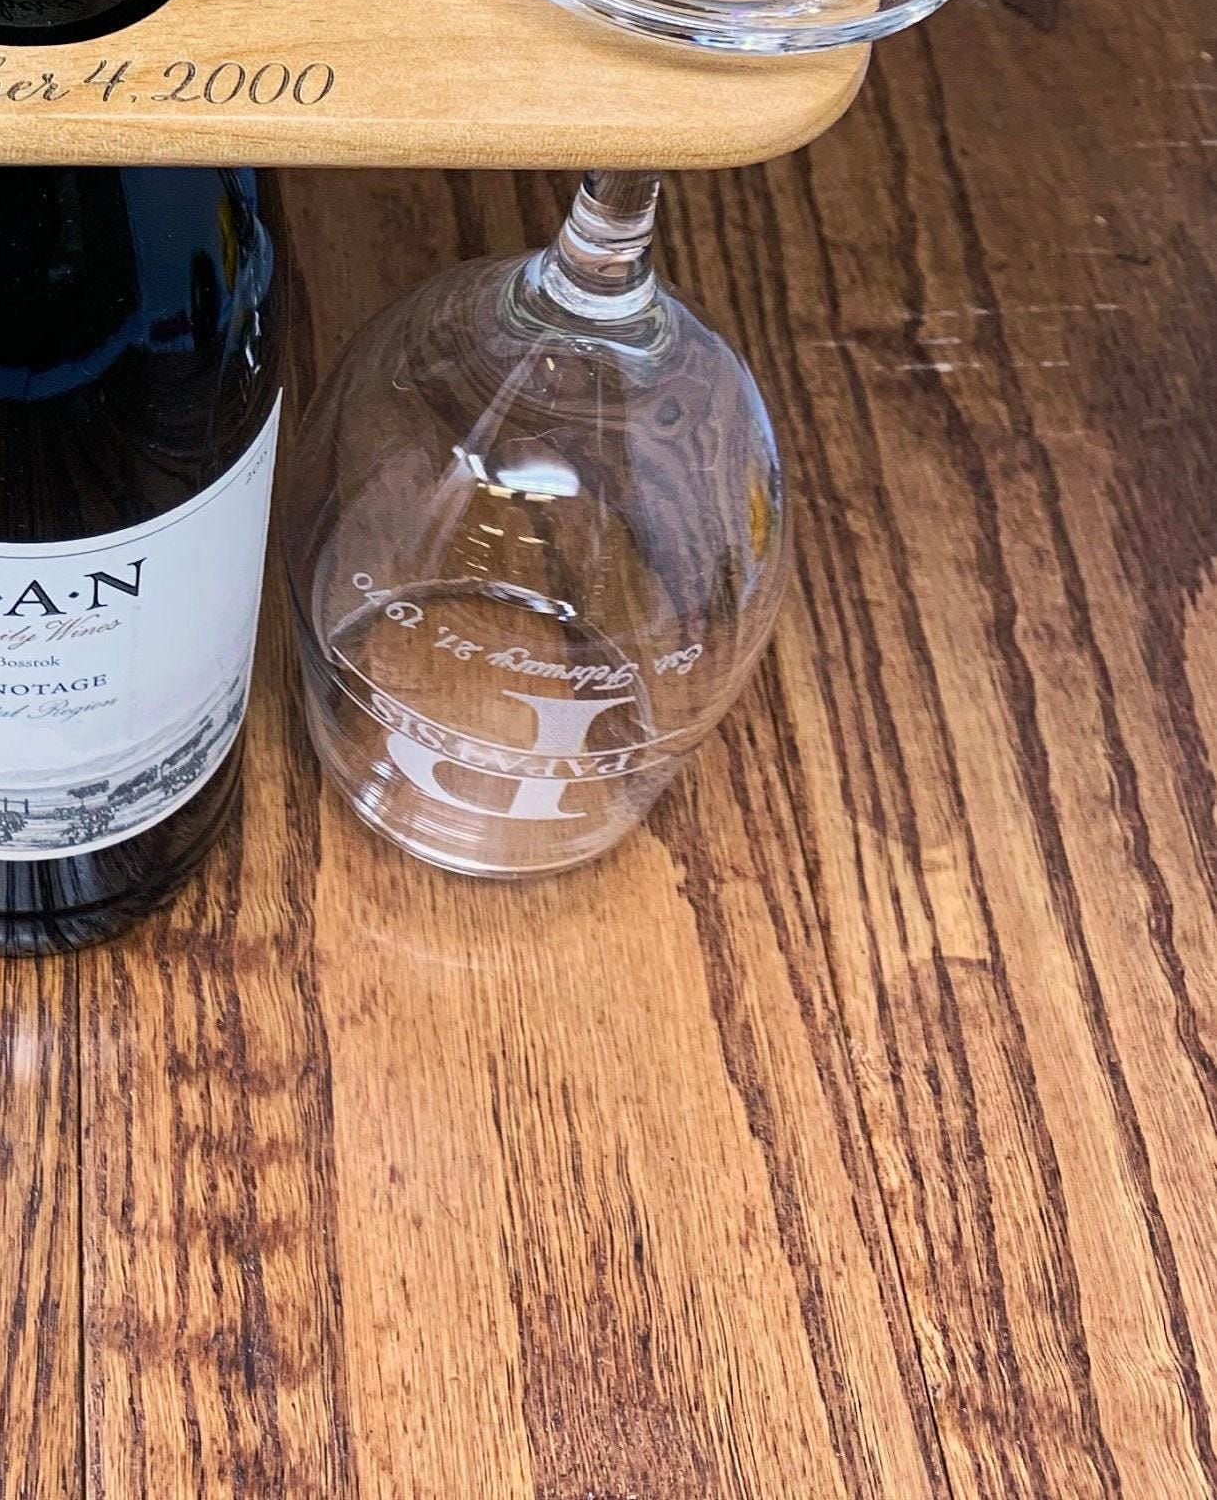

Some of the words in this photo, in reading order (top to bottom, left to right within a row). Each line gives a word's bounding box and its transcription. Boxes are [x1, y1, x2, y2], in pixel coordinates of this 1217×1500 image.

[84, 59, 137, 103] 4,
[151, 60, 335, 105] 2000
[45, 614, 122, 643] Wines
[433, 626, 484, 662] 21,
[485, 645, 639, 692] February
[27, 698, 119, 722] Region
